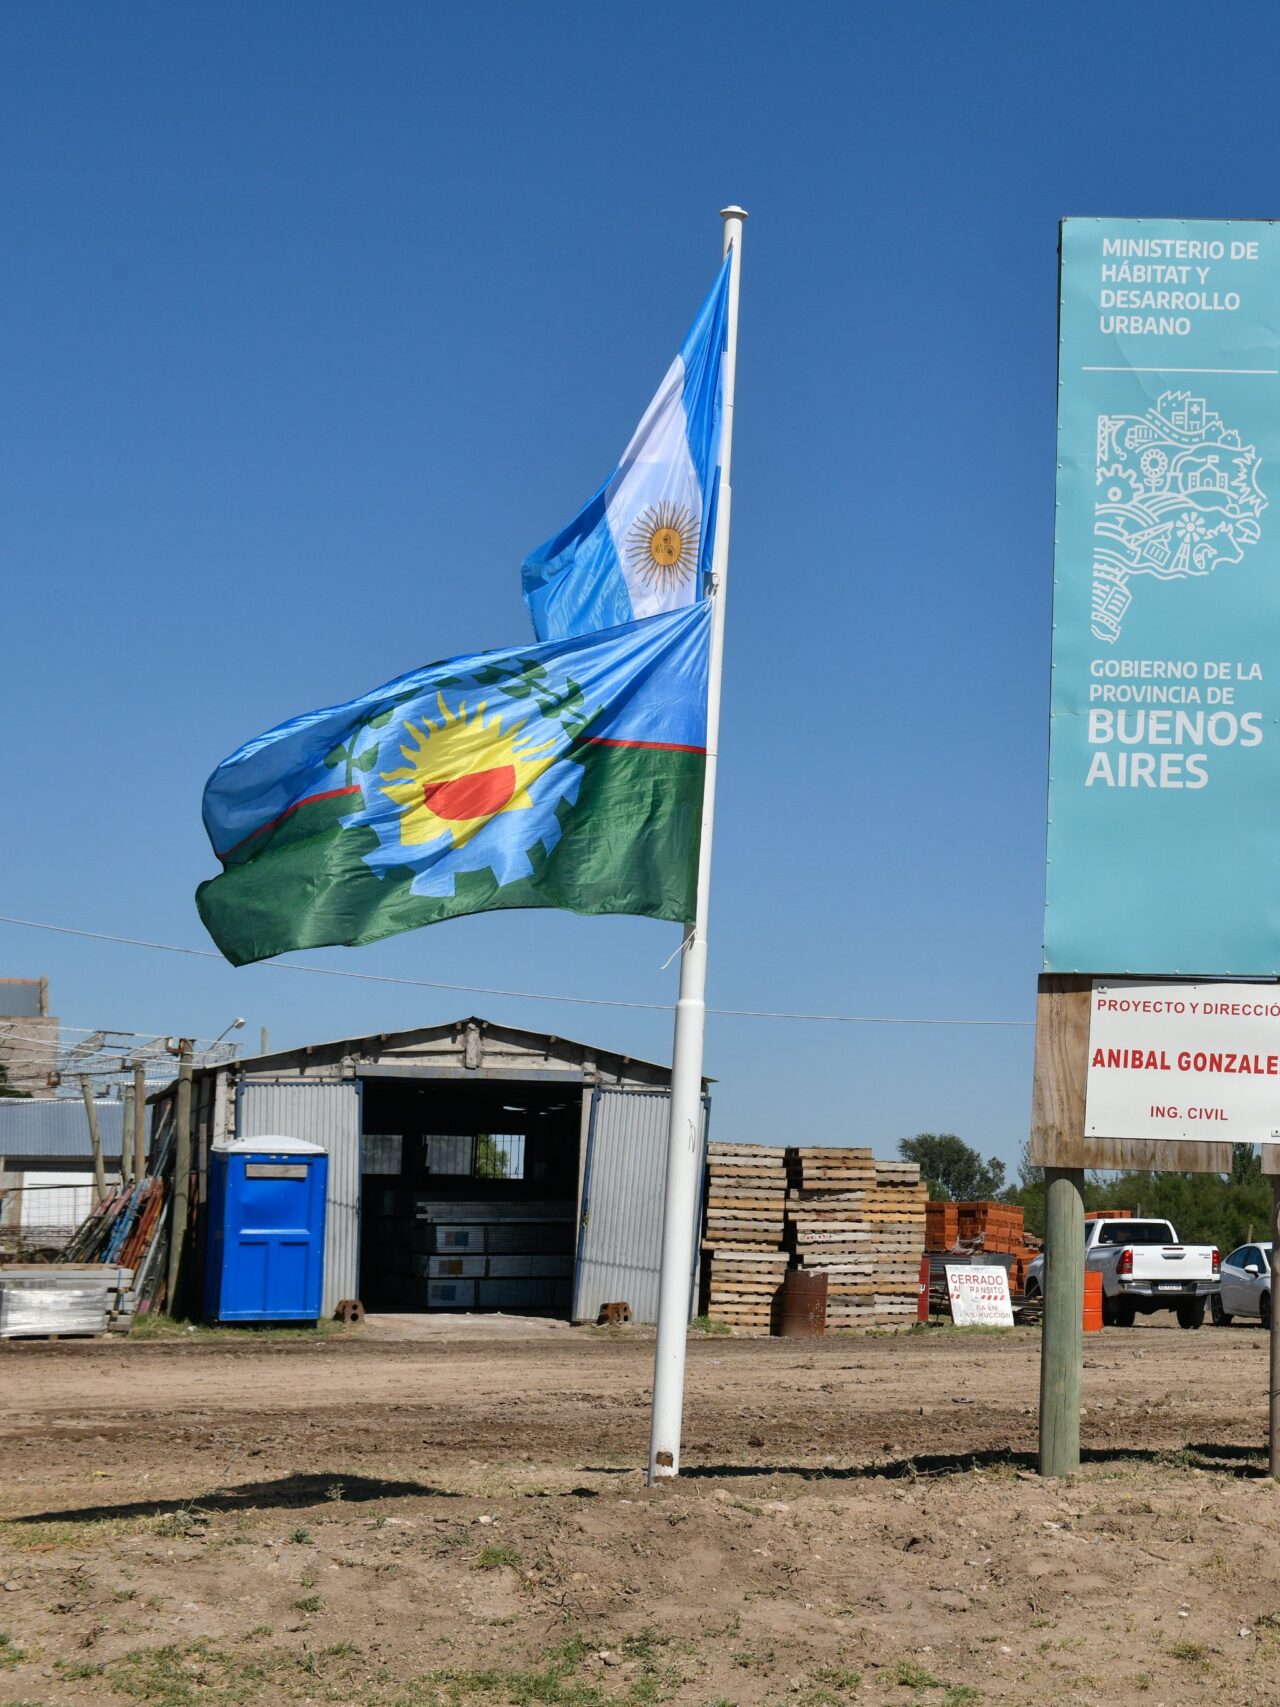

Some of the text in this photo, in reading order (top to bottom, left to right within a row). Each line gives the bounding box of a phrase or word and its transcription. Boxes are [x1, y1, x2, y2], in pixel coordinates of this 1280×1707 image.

[1102, 238, 1259, 261] MINISTERIO DE
[1101, 259, 1211, 285] HÁBITAT Y
[1100, 289, 1241, 311] DESARROLLO
[1100, 314, 1191, 336] URBANO
[1090, 659, 1264, 681] GOBIERNO DE LA
[1089, 684, 1234, 705] PROVINCIA DE
[1087, 709, 1264, 747] BUENOS
[1085, 752, 1210, 789] AIRES
[1097, 999, 1185, 1014] PROYECTO
[1190, 1002, 1200, 1014] Y
[1092, 1048, 1171, 1070] ANIBAL
[1150, 1105, 1229, 1121] ING. CIVIL
[950, 1274, 1003, 1285] CERRADO
[970, 1286, 1004, 1294] RANSITO
